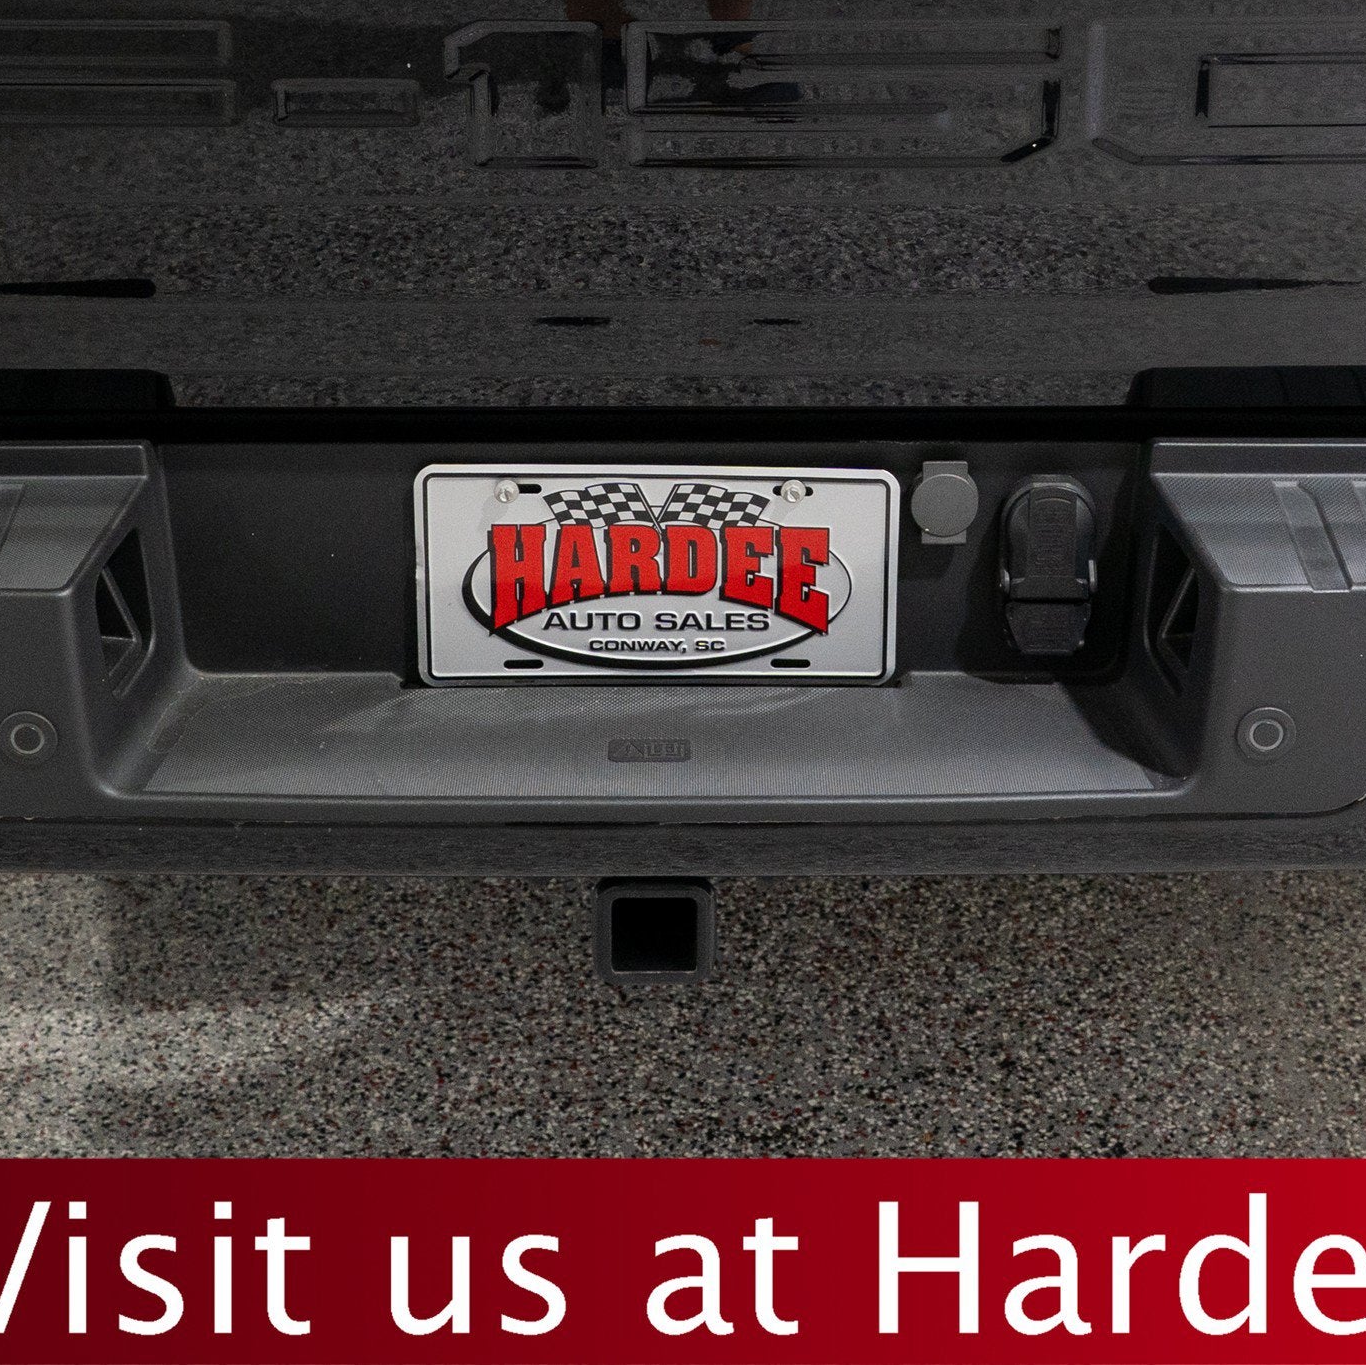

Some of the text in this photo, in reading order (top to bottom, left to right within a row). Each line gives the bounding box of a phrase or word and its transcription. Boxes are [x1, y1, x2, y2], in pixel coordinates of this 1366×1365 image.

[487, 523, 830, 636] HARDEE
[542, 611, 771, 632] AUTO SALES
[588, 639, 726, 654] CONWAY, SC
